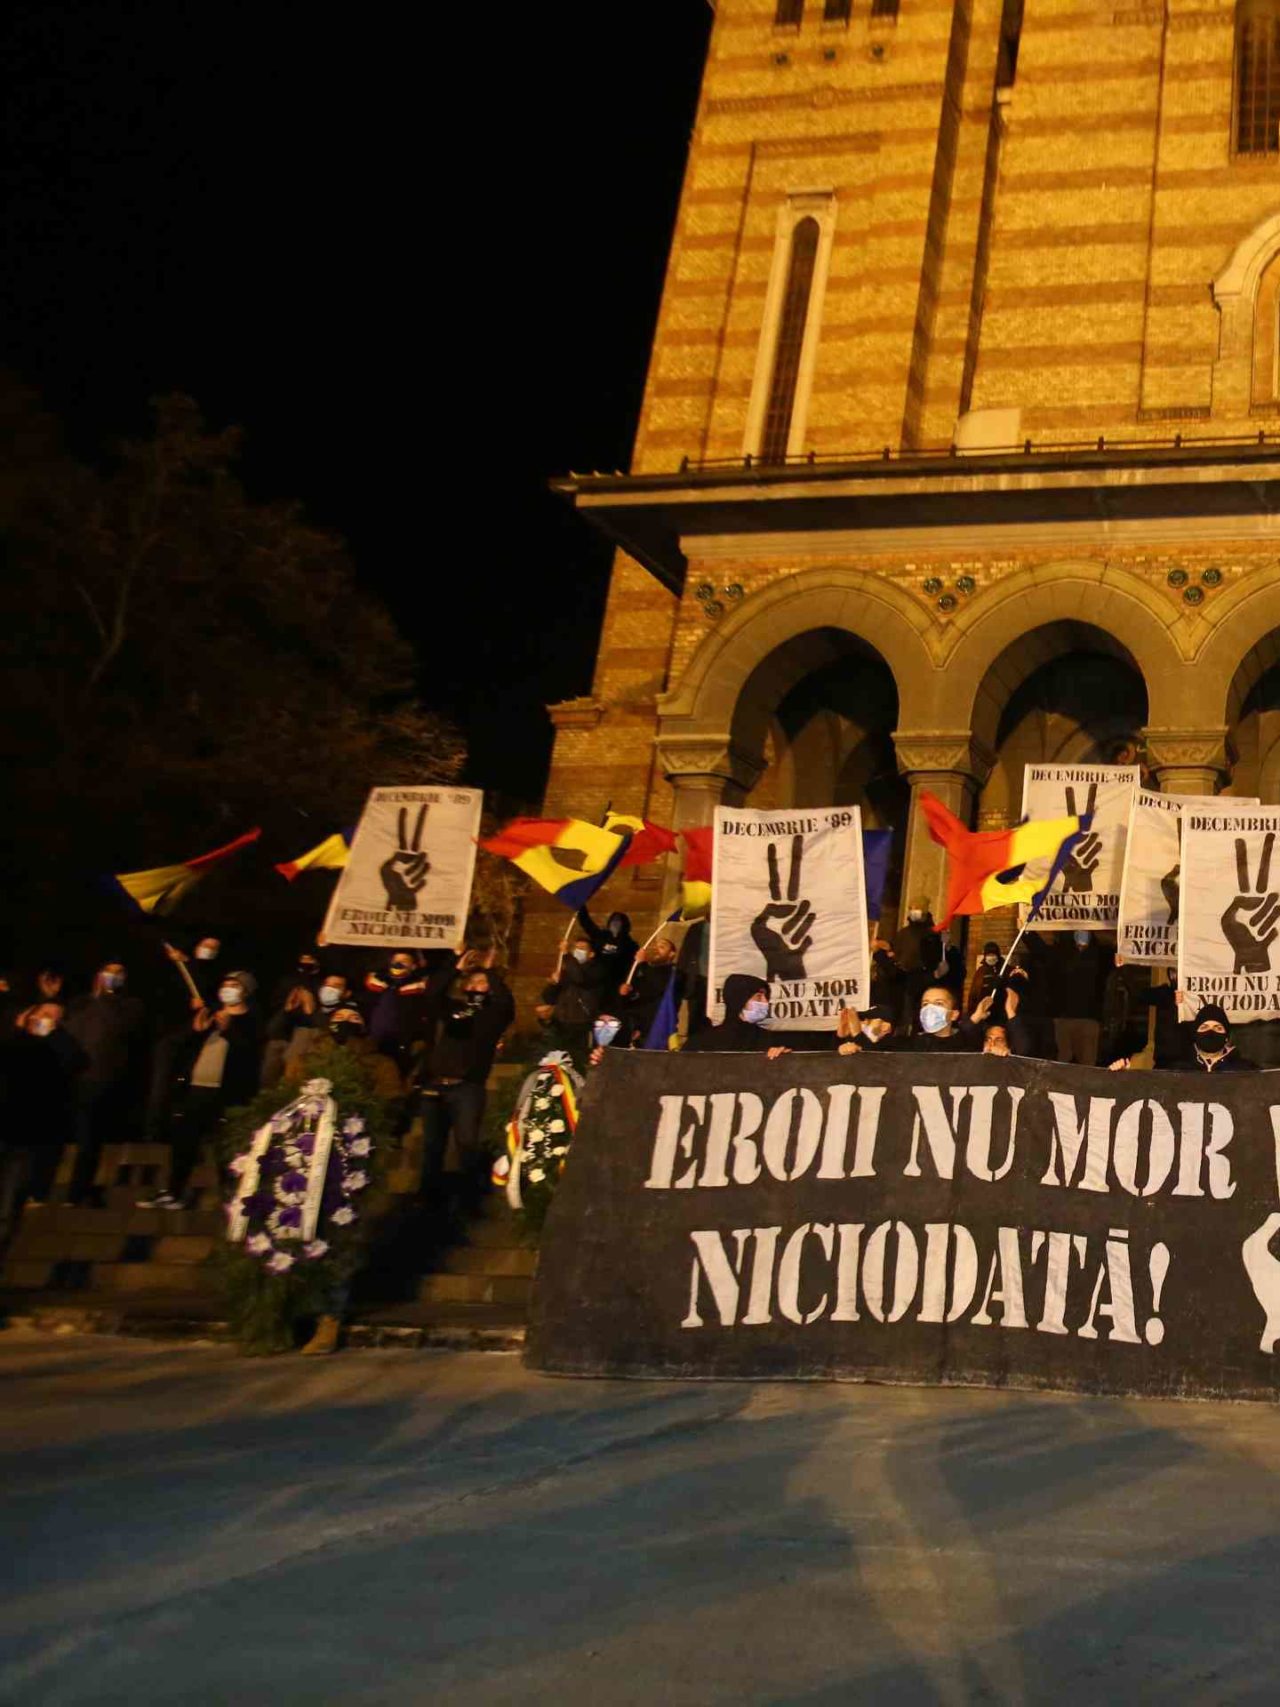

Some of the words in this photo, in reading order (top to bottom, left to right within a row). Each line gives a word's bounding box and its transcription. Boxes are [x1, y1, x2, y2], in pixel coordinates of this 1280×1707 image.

[1031, 769, 1109, 783] DECEMBRIE
[1114, 772, 1134, 783] '89
[722, 817, 818, 837] DECEMBRIE
[824, 812, 852, 829] '89
[1071, 894, 1091, 906] NU
[1125, 925, 1170, 939] EROII
[779, 983, 806, 999] NU
[814, 979, 859, 998] MOR
[1186, 976, 1237, 992] EROII
[1244, 976, 1269, 992] NU
[644, 1084, 887, 1189] EROII
[903, 1085, 1026, 1182] NU
[1040, 1091, 1237, 1199] MOR
